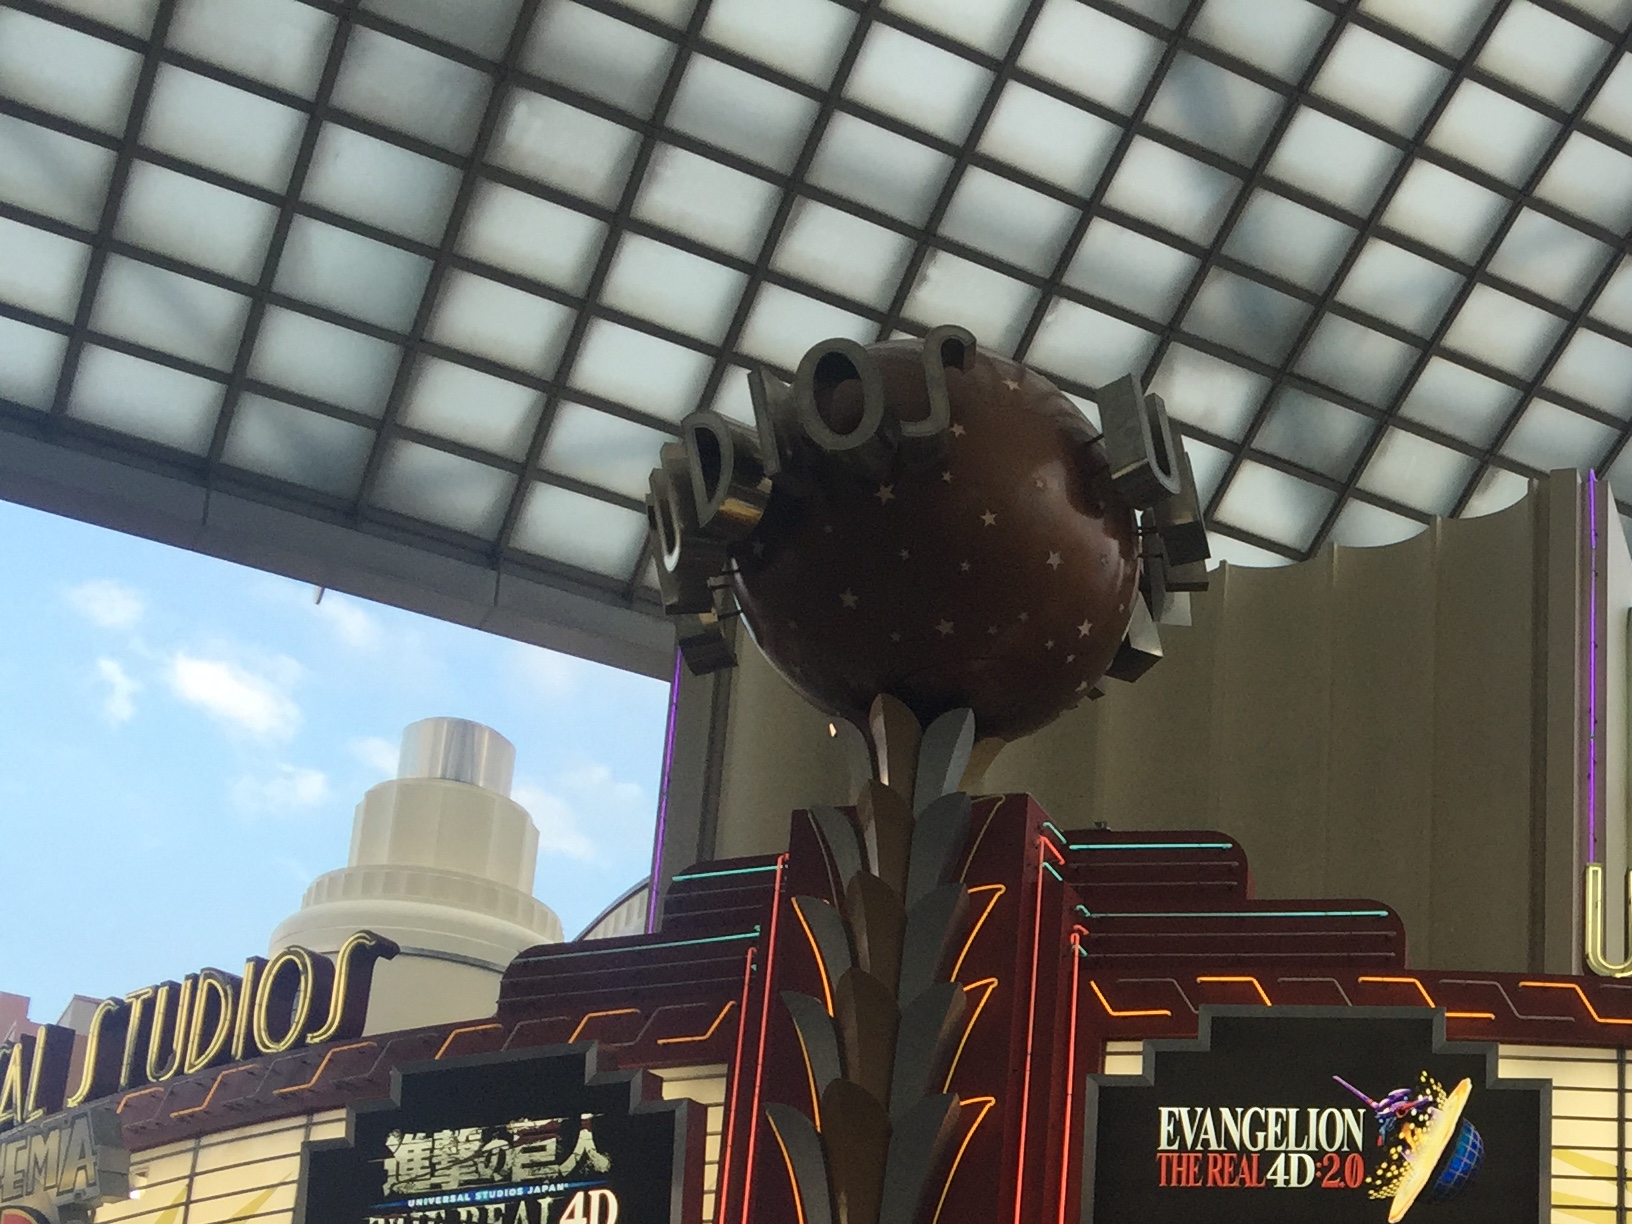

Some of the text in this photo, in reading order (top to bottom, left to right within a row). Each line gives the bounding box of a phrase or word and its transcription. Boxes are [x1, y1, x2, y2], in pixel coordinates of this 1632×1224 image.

[66, 930, 385, 1108] STUDIOS
[0, 1112, 98, 1200] EMA
[383, 1112, 613, 1198] 進撃の巨人
[1157, 1106, 1366, 1152] EVANGELION
[407, 1192, 471, 1208] UNIVERSAL
[475, 1187, 524, 1201] STUDIOS
[1157, 1153, 1203, 1188] THE
[1206, 1153, 1266, 1188] REAL
